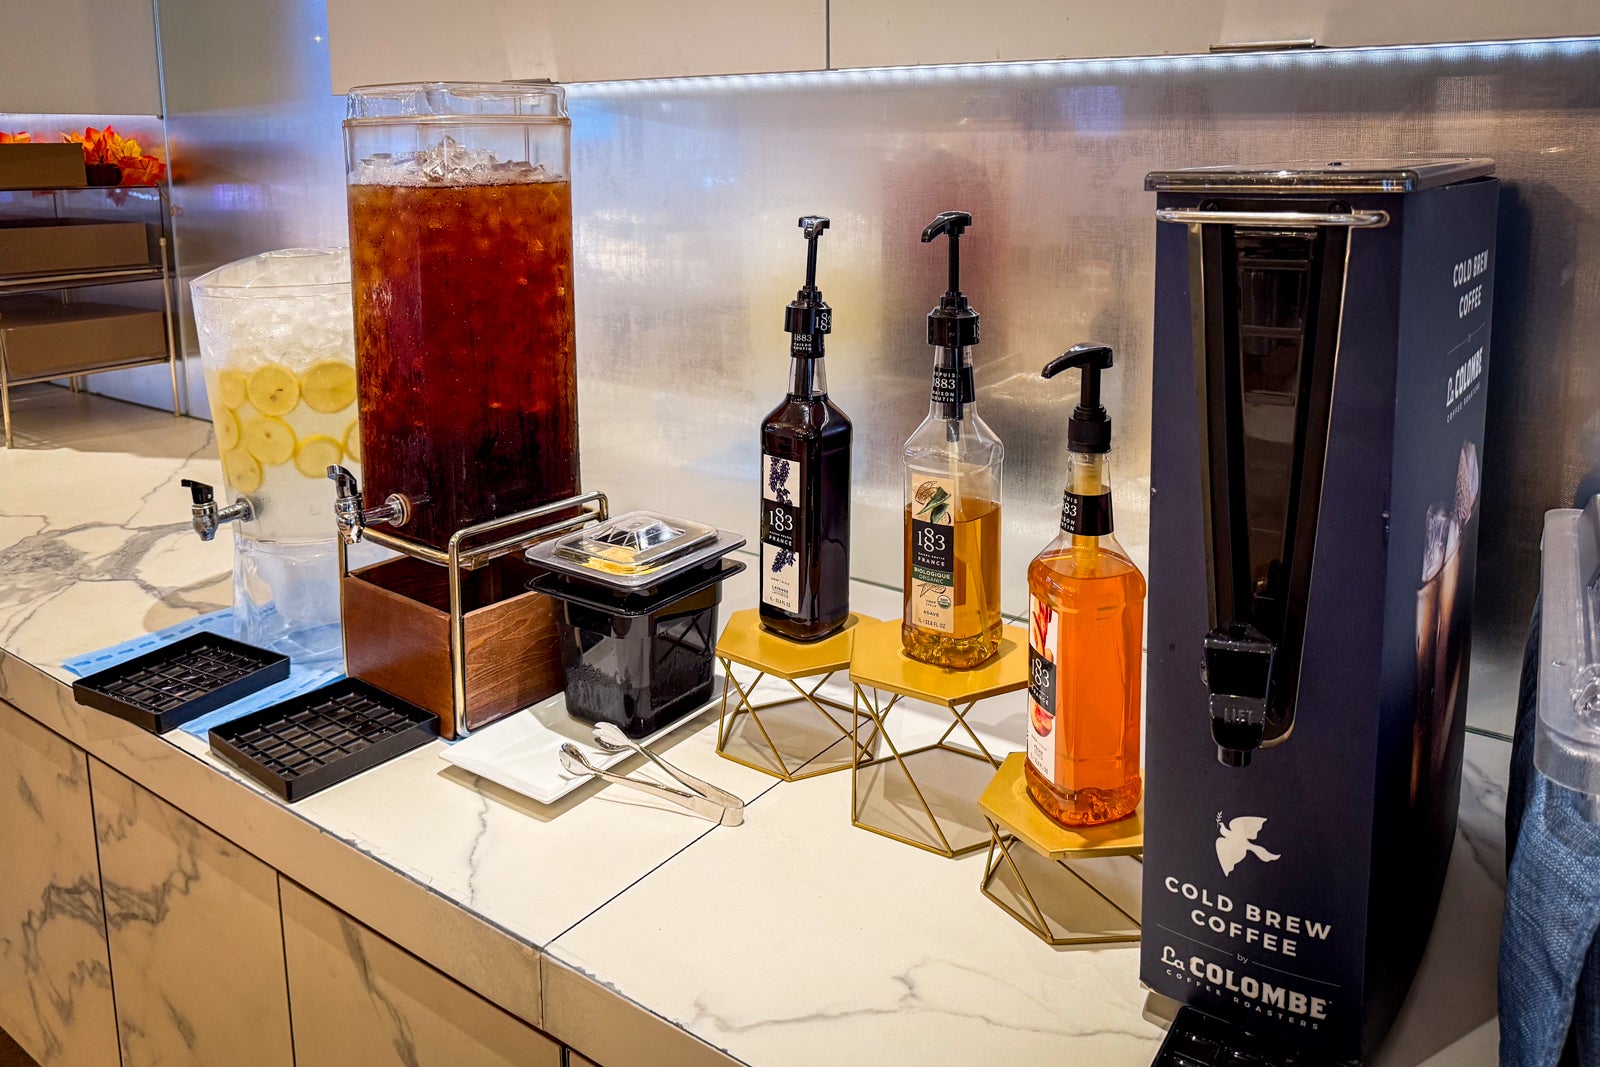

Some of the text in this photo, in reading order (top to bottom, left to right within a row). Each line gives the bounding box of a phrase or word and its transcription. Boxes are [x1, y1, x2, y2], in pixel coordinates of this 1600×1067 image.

[1453, 249, 1489, 288] COLD BREW
[1458, 284, 1482, 319] COFFEE
[1446, 346, 1484, 408] La COLOMBE
[768, 534, 793, 547] FRANCE
[913, 566, 951, 580] BIOLOGIQUE
[917, 556, 946, 567] FRANCE
[923, 609, 940, 618] AGAVE
[1223, 707, 1254, 727] LIFT
[1164, 875, 1332, 941] COLD BREW
[1190, 908, 1298, 957] COFFEE
[1236, 952, 1249, 964] by
[1160, 945, 1328, 1021] La COLOMBE
[1166, 968, 1319, 1031] COFFEE ROASTERS
